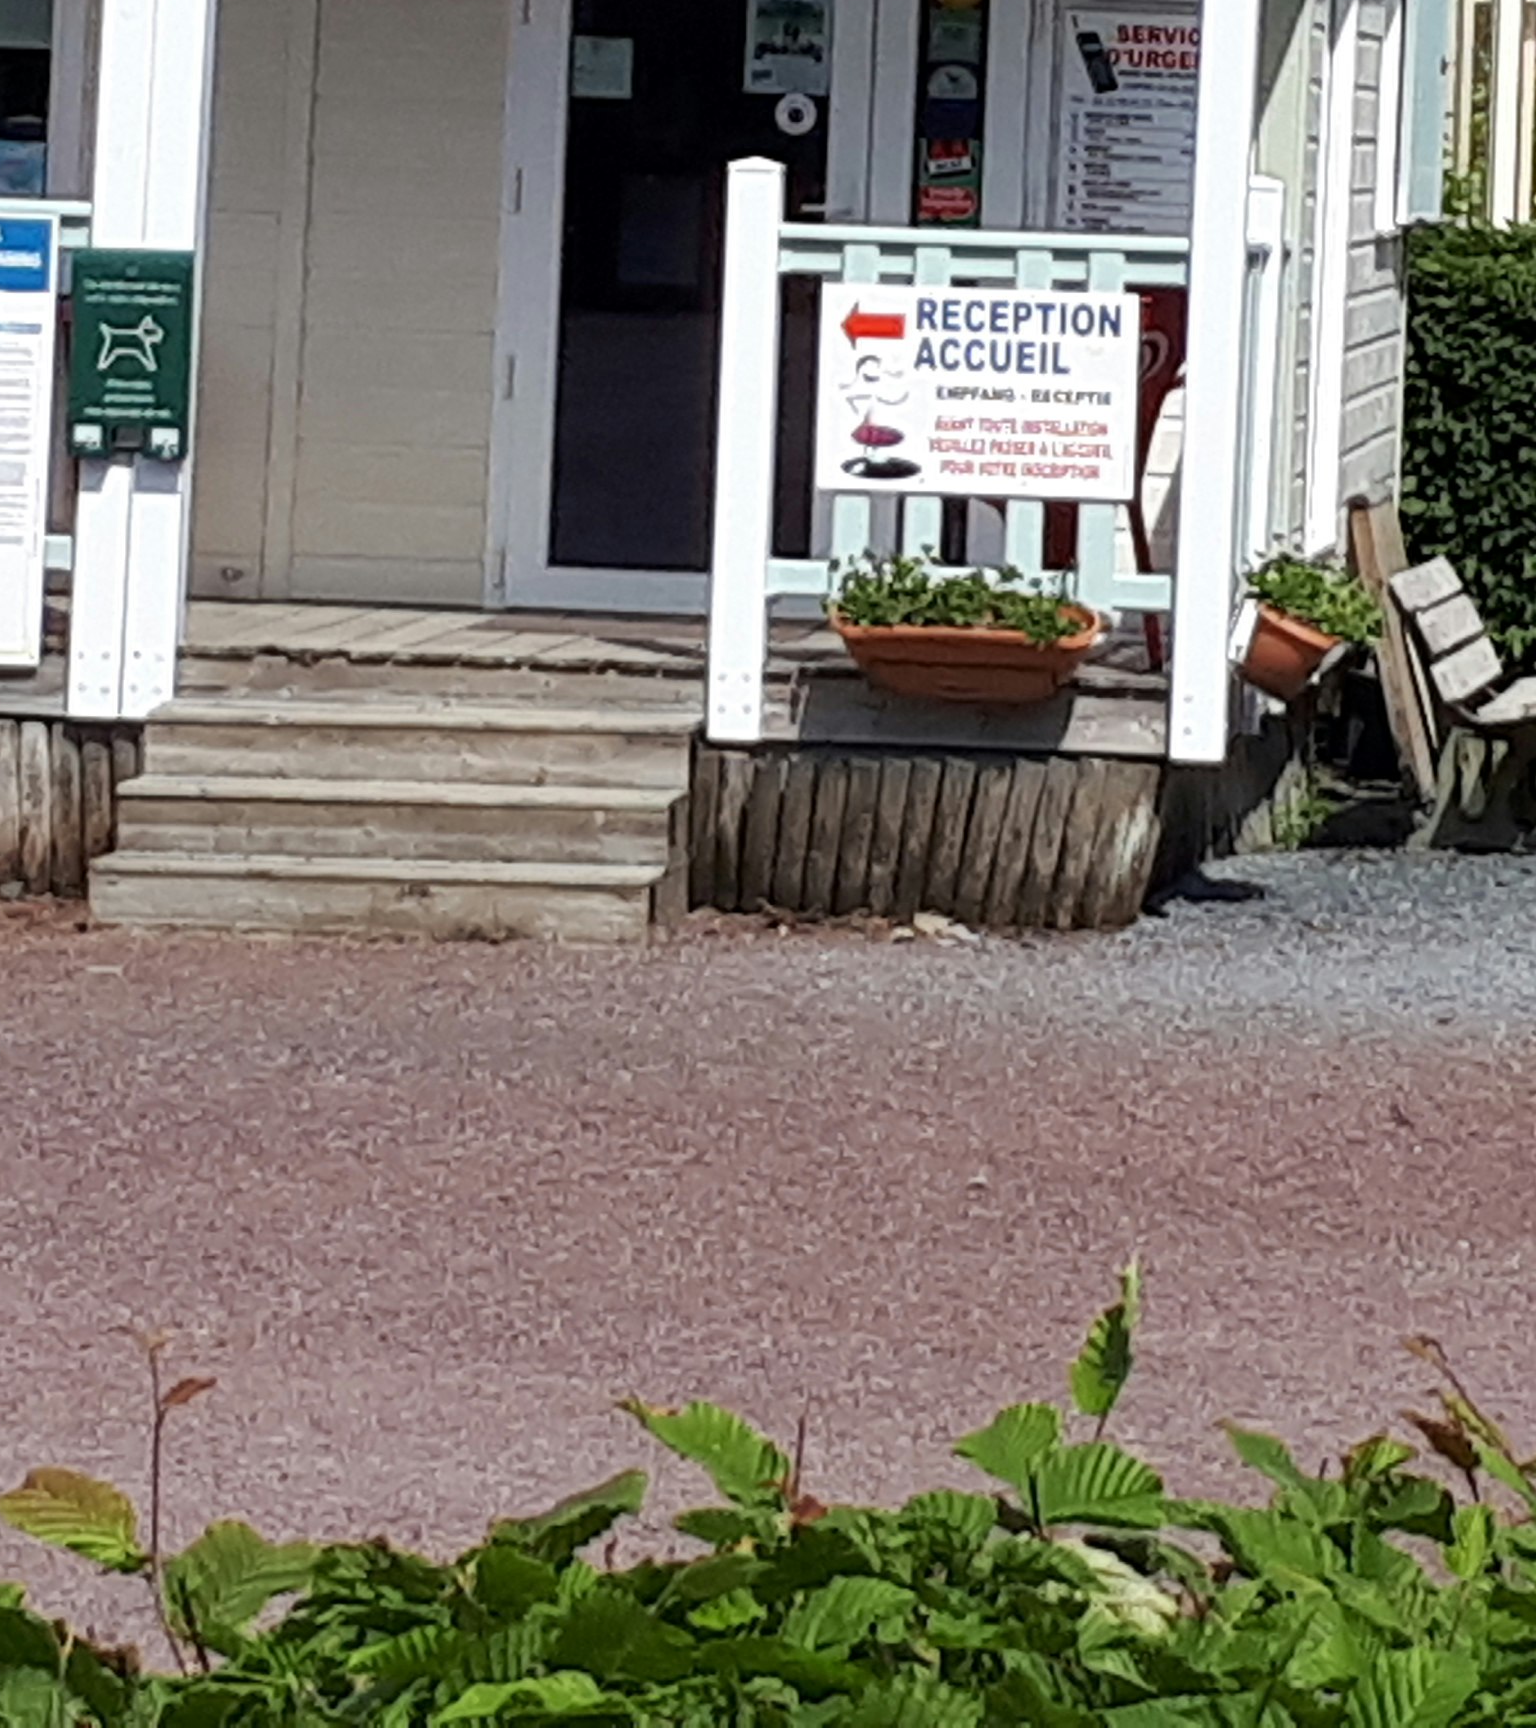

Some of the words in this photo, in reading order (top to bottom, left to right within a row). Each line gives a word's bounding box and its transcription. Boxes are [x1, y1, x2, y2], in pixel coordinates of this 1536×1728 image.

[1116, 23, 1200, 47] SERVIC
[916, 297, 1122, 338] RECEPTION
[914, 336, 1072, 374] ACCUEIL
[936, 385, 1016, 403] EMPFANG
[1031, 388, 1112, 405] RECEPTIE
